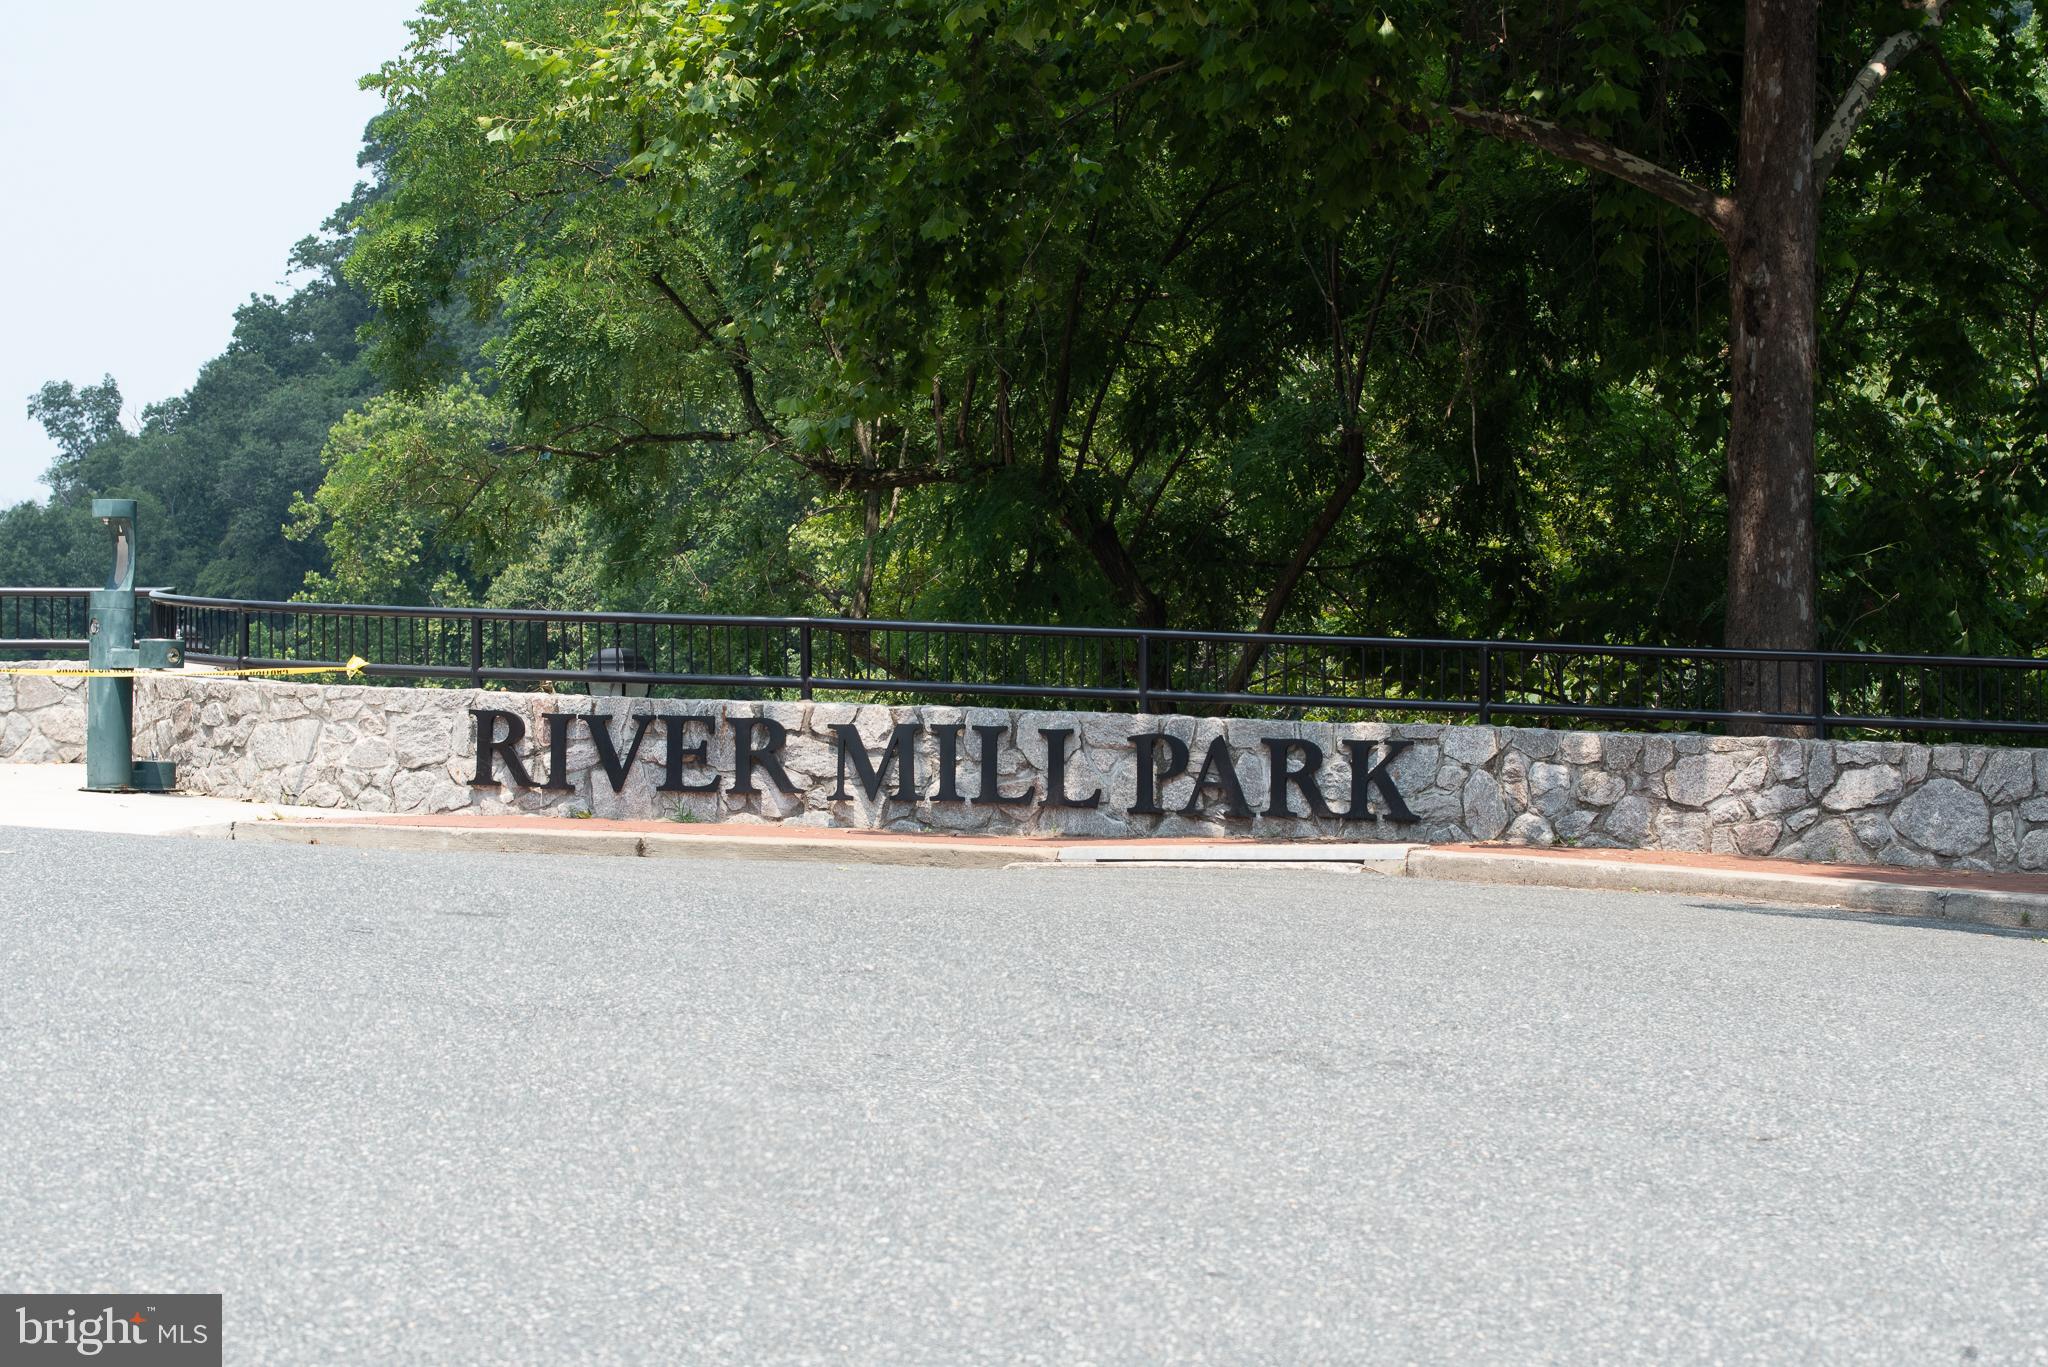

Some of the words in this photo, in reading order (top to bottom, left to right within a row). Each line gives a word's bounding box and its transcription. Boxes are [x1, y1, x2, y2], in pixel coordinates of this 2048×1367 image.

[466, 709, 804, 795] RIVER
[826, 722, 1101, 808] MILL
[1126, 732, 1421, 822] PARK
